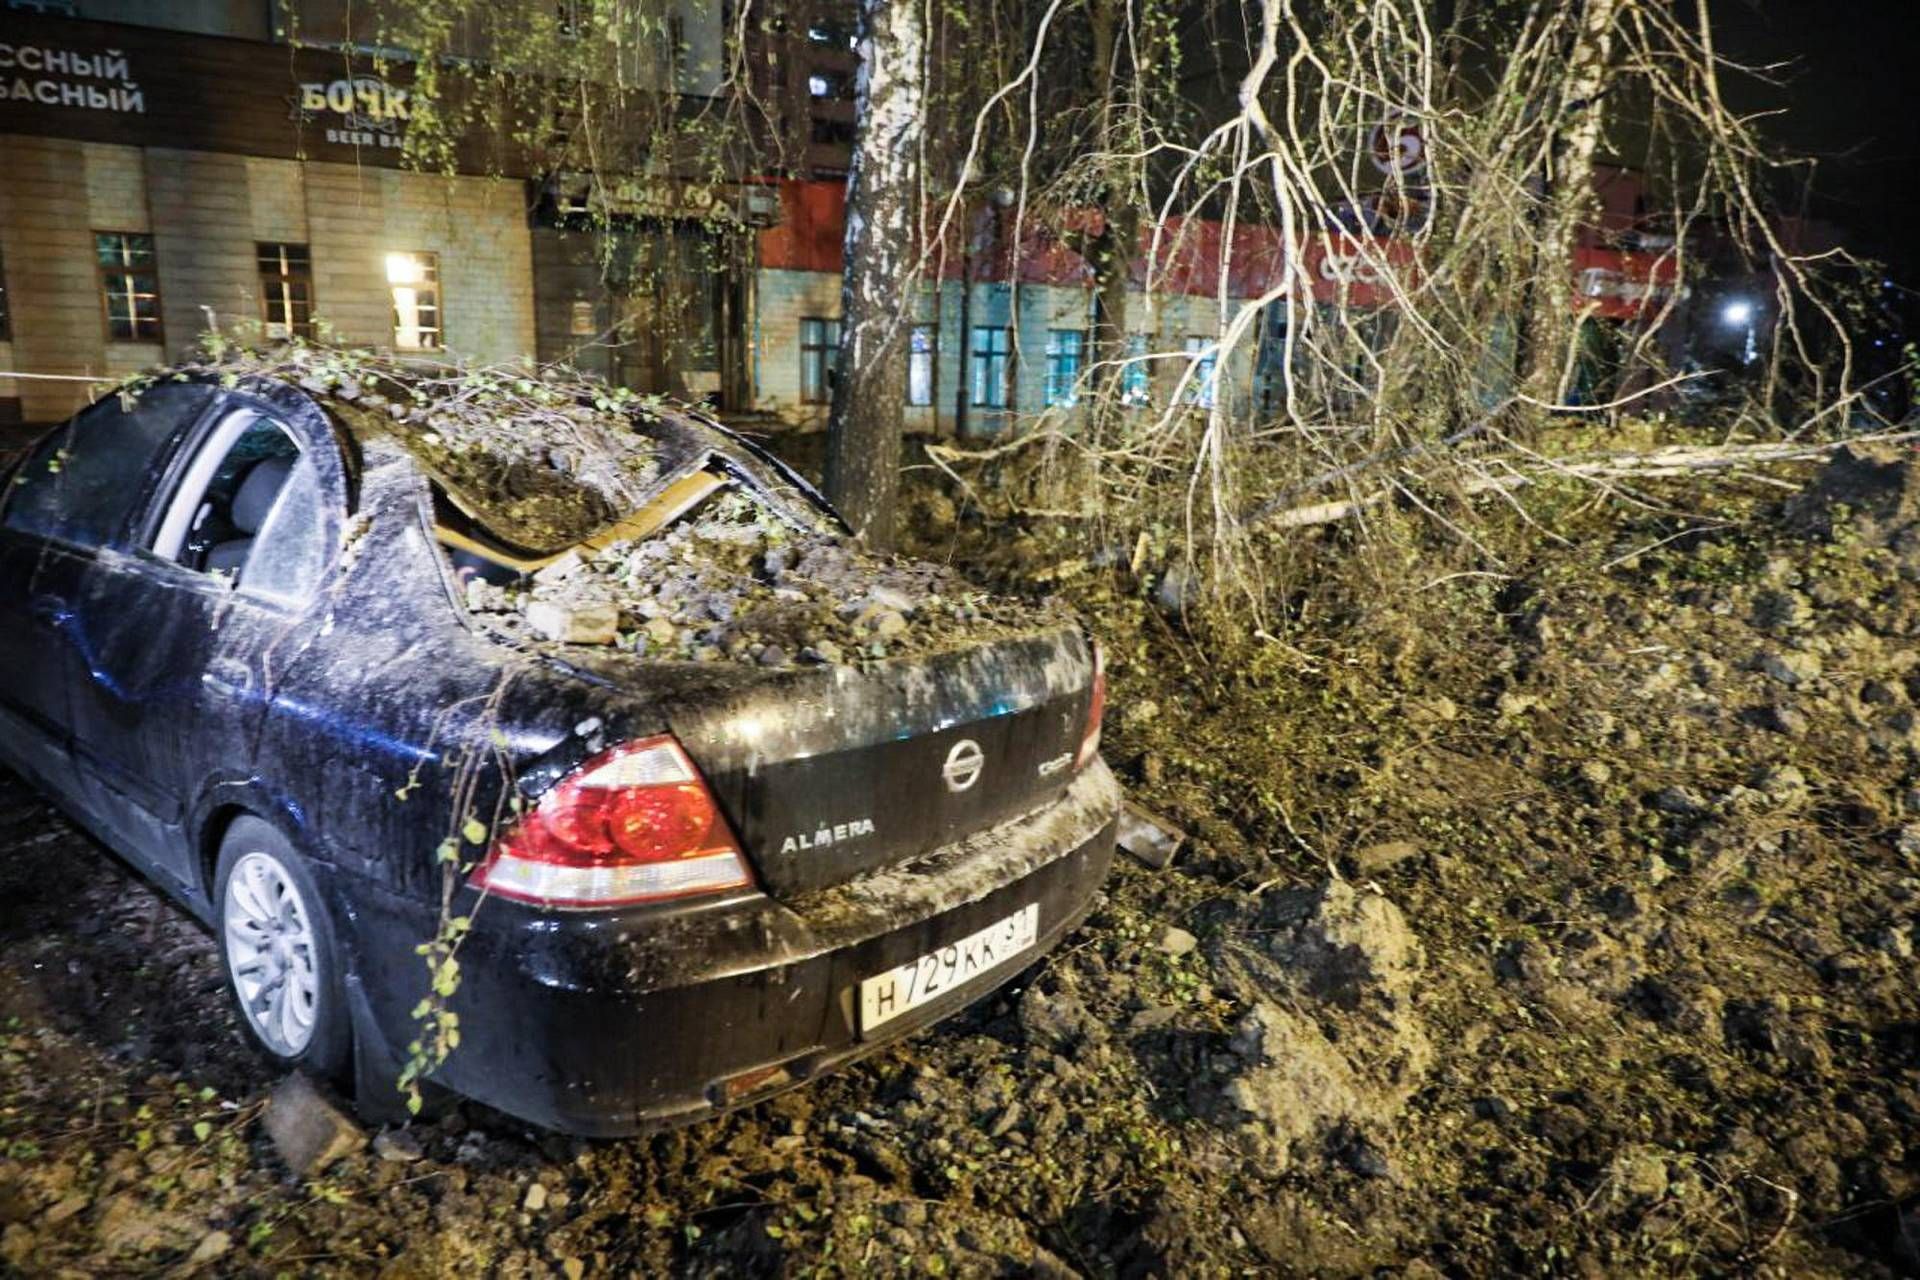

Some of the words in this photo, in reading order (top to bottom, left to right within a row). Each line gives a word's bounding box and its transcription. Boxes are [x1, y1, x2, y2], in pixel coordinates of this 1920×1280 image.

[300, 79, 418, 121] БОЧК
[326, 129, 375, 145] BEER
[379, 133, 408, 148] BA
[780, 818, 875, 854] ALMERA
